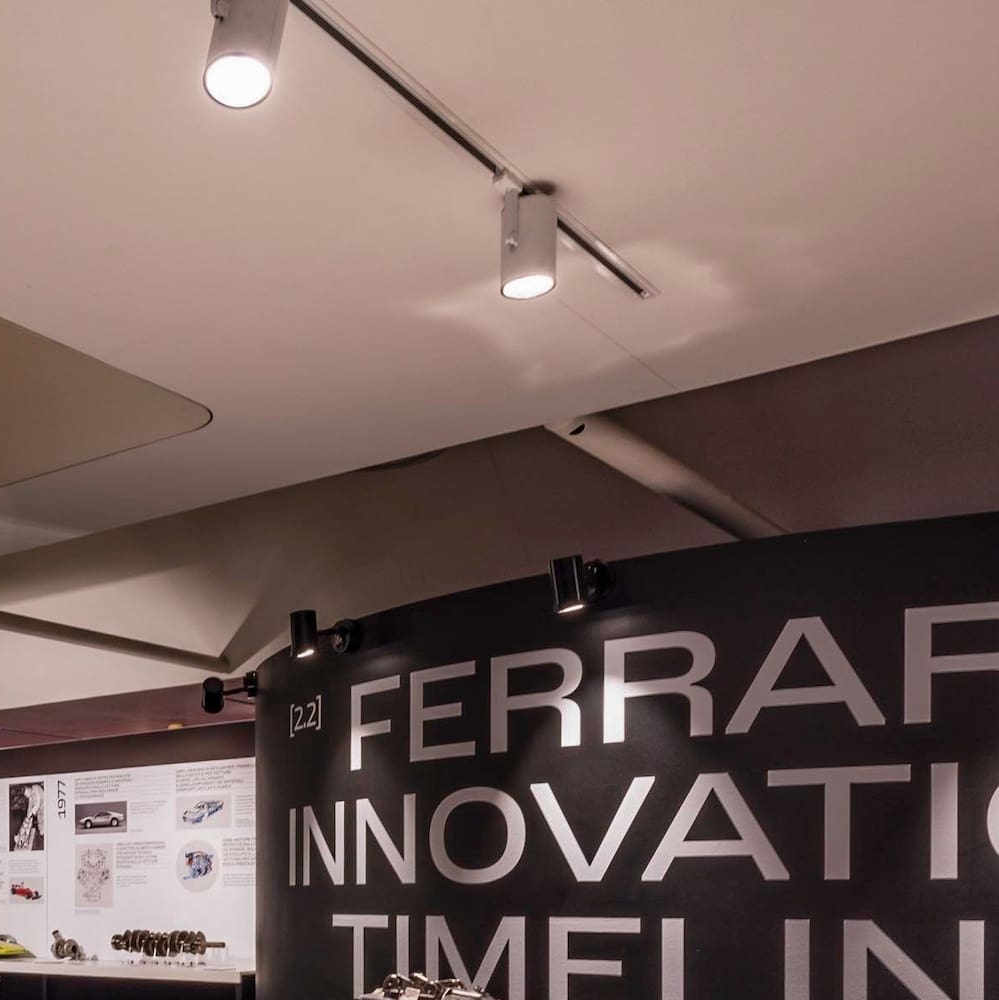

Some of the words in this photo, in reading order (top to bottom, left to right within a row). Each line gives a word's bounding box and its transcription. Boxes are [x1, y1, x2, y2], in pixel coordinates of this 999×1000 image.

[289, 695, 322, 738] [2.2]
[57, 780, 66, 818] 1977
[289, 762, 999, 887] INNOVATI
